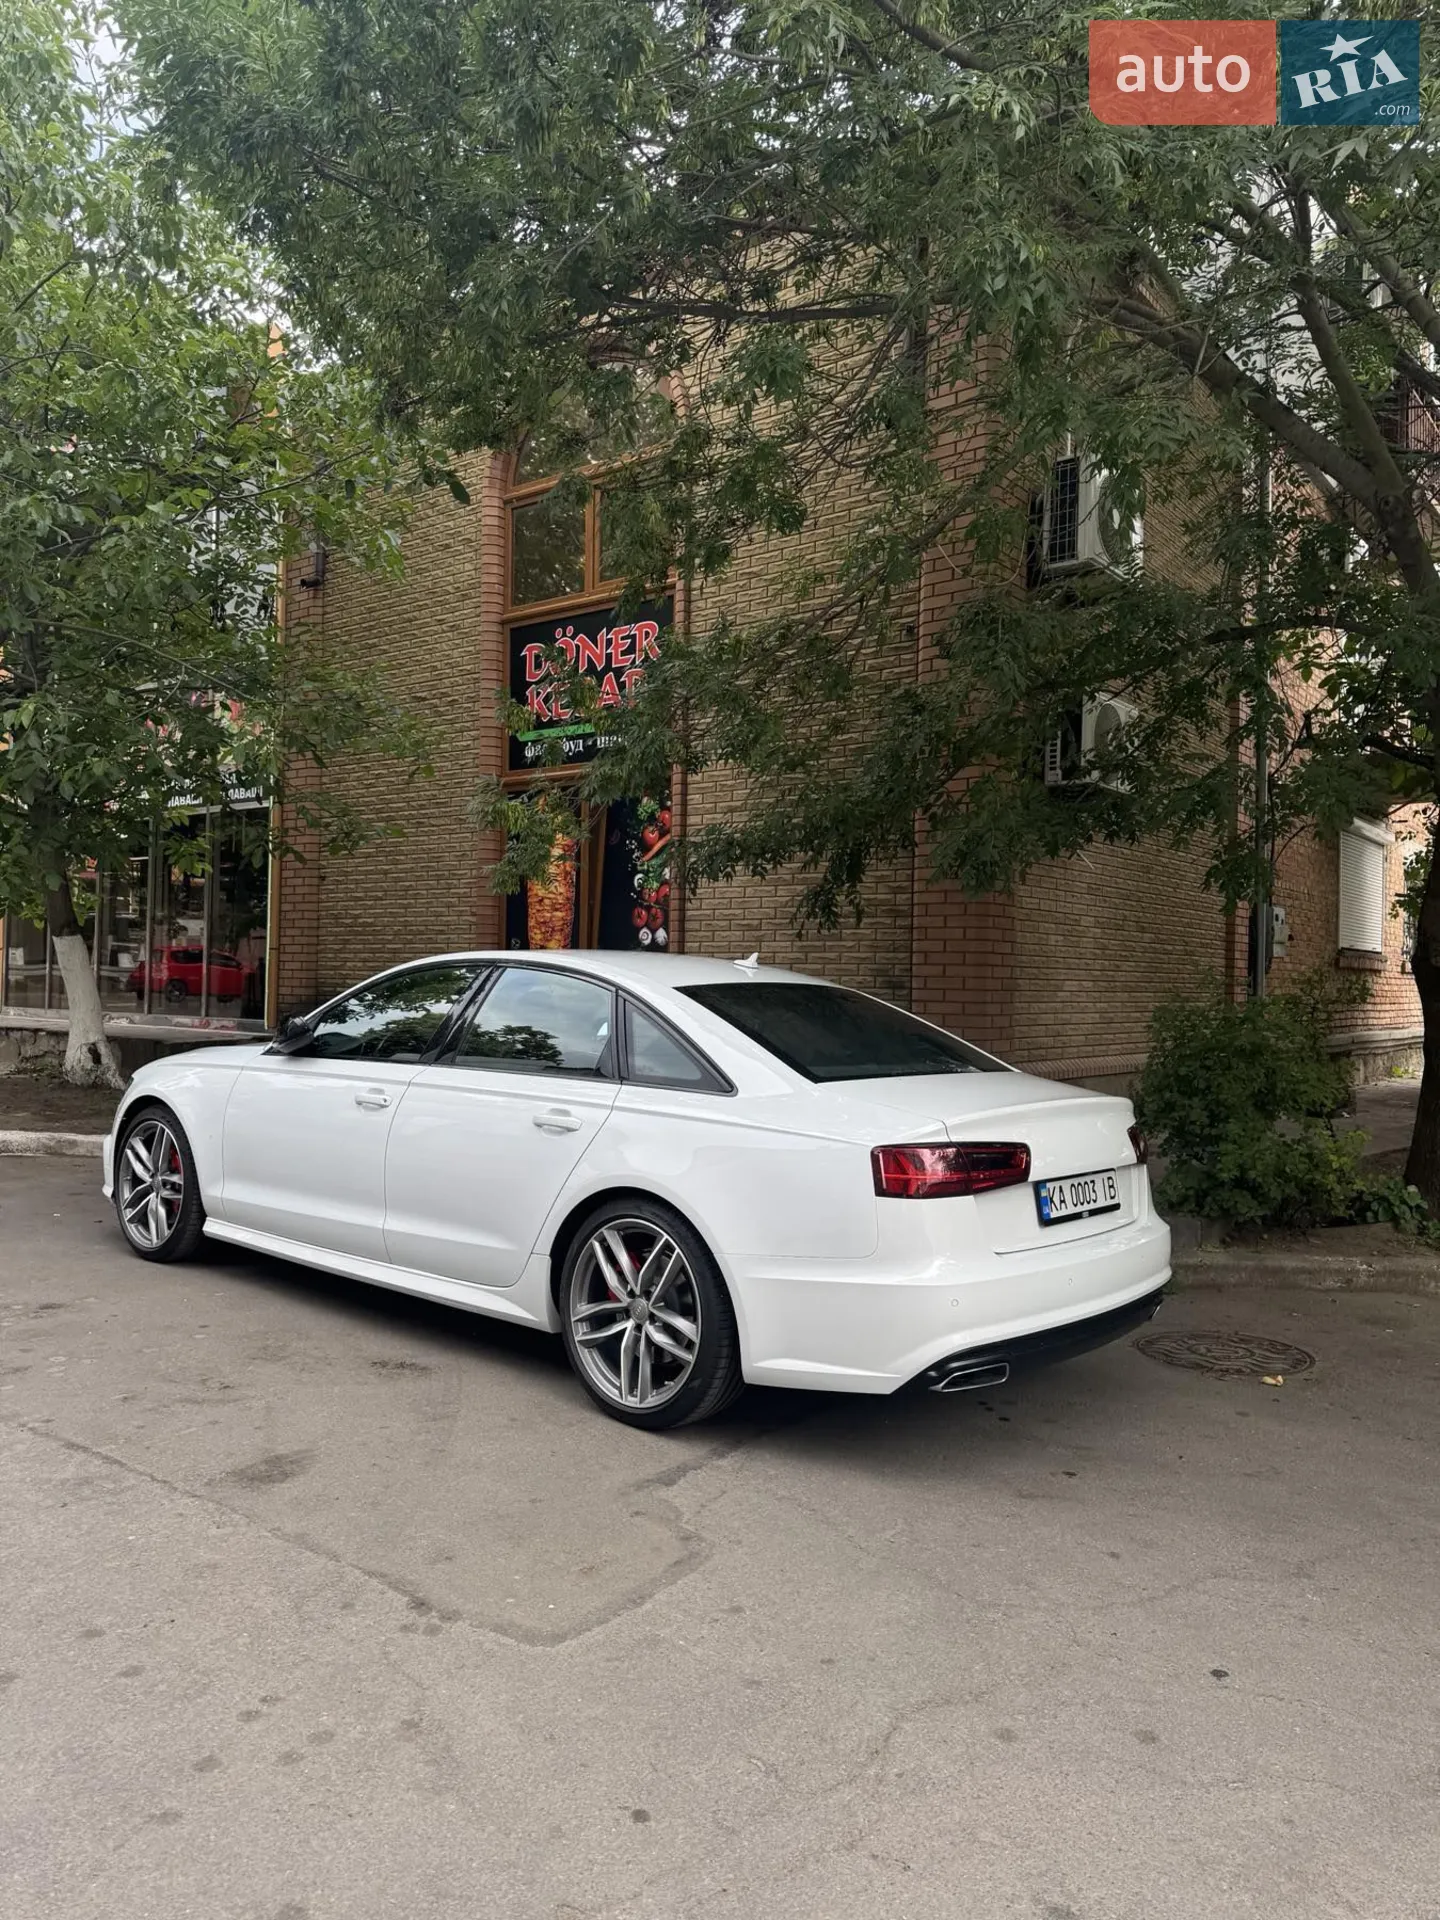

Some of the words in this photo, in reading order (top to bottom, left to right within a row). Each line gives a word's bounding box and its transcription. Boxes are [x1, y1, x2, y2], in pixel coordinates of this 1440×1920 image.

[520, 620, 662, 682] DÖNER
[1047, 1184, 1068, 1212] KA
[1070, 1180, 1098, 1208] 0003
[1102, 1176, 1117, 1201] IB
